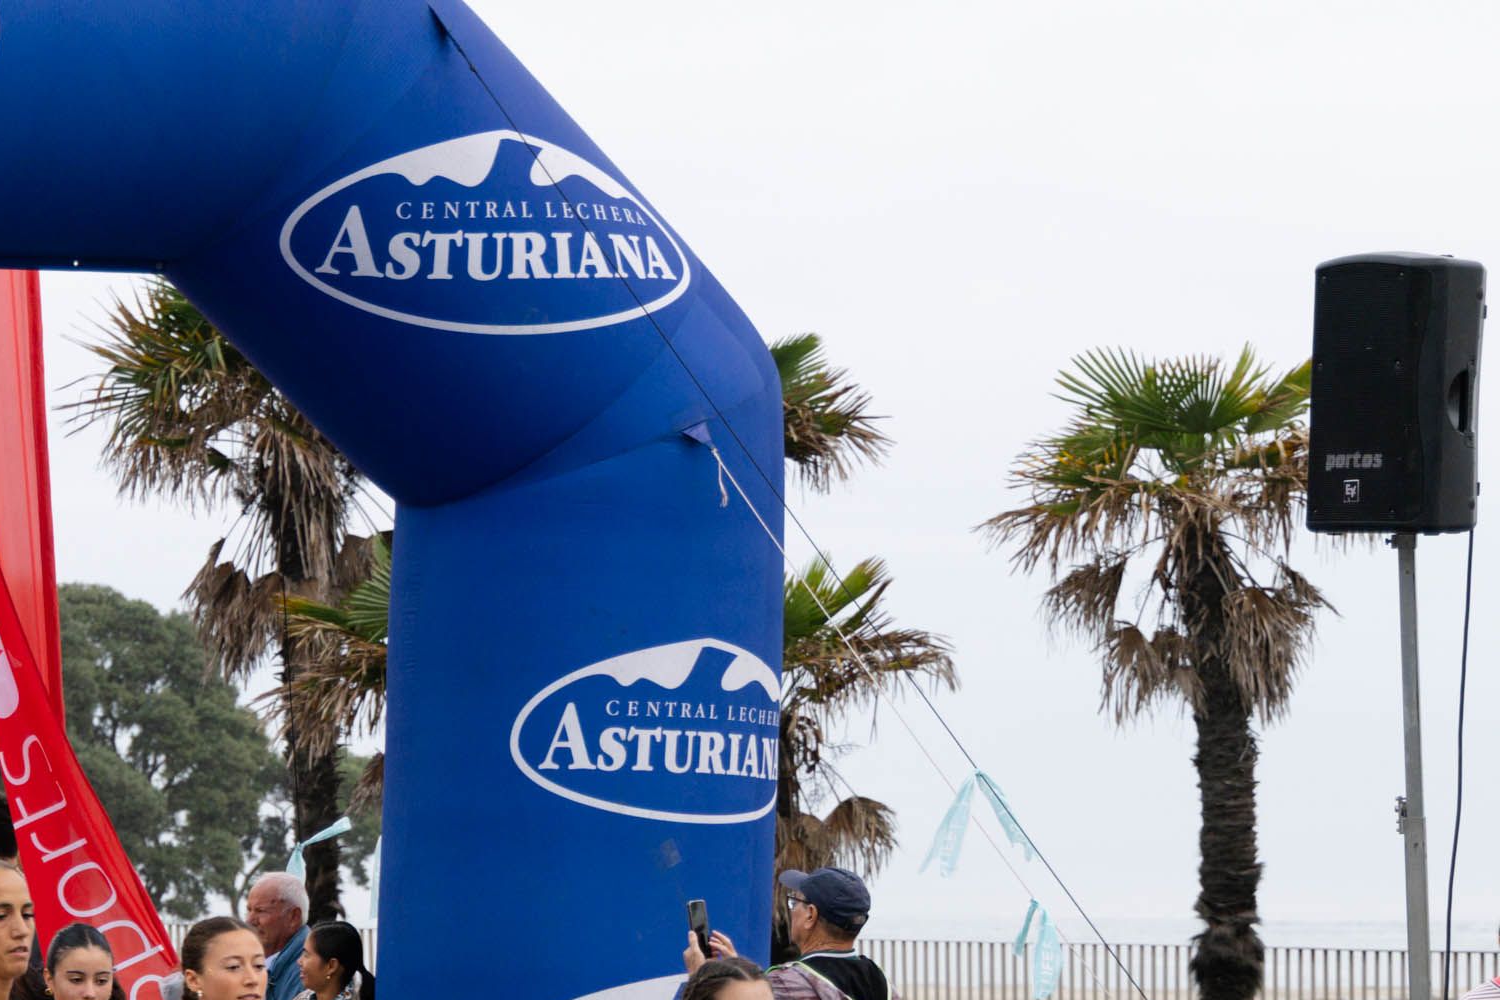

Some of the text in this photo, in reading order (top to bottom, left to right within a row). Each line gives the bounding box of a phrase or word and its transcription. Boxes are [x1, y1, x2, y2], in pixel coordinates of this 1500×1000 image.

[396, 201, 647, 226] CENTRAL LECHERA
[315, 205, 677, 281] ASTURIANA
[605, 700, 718, 719] CENTRAL
